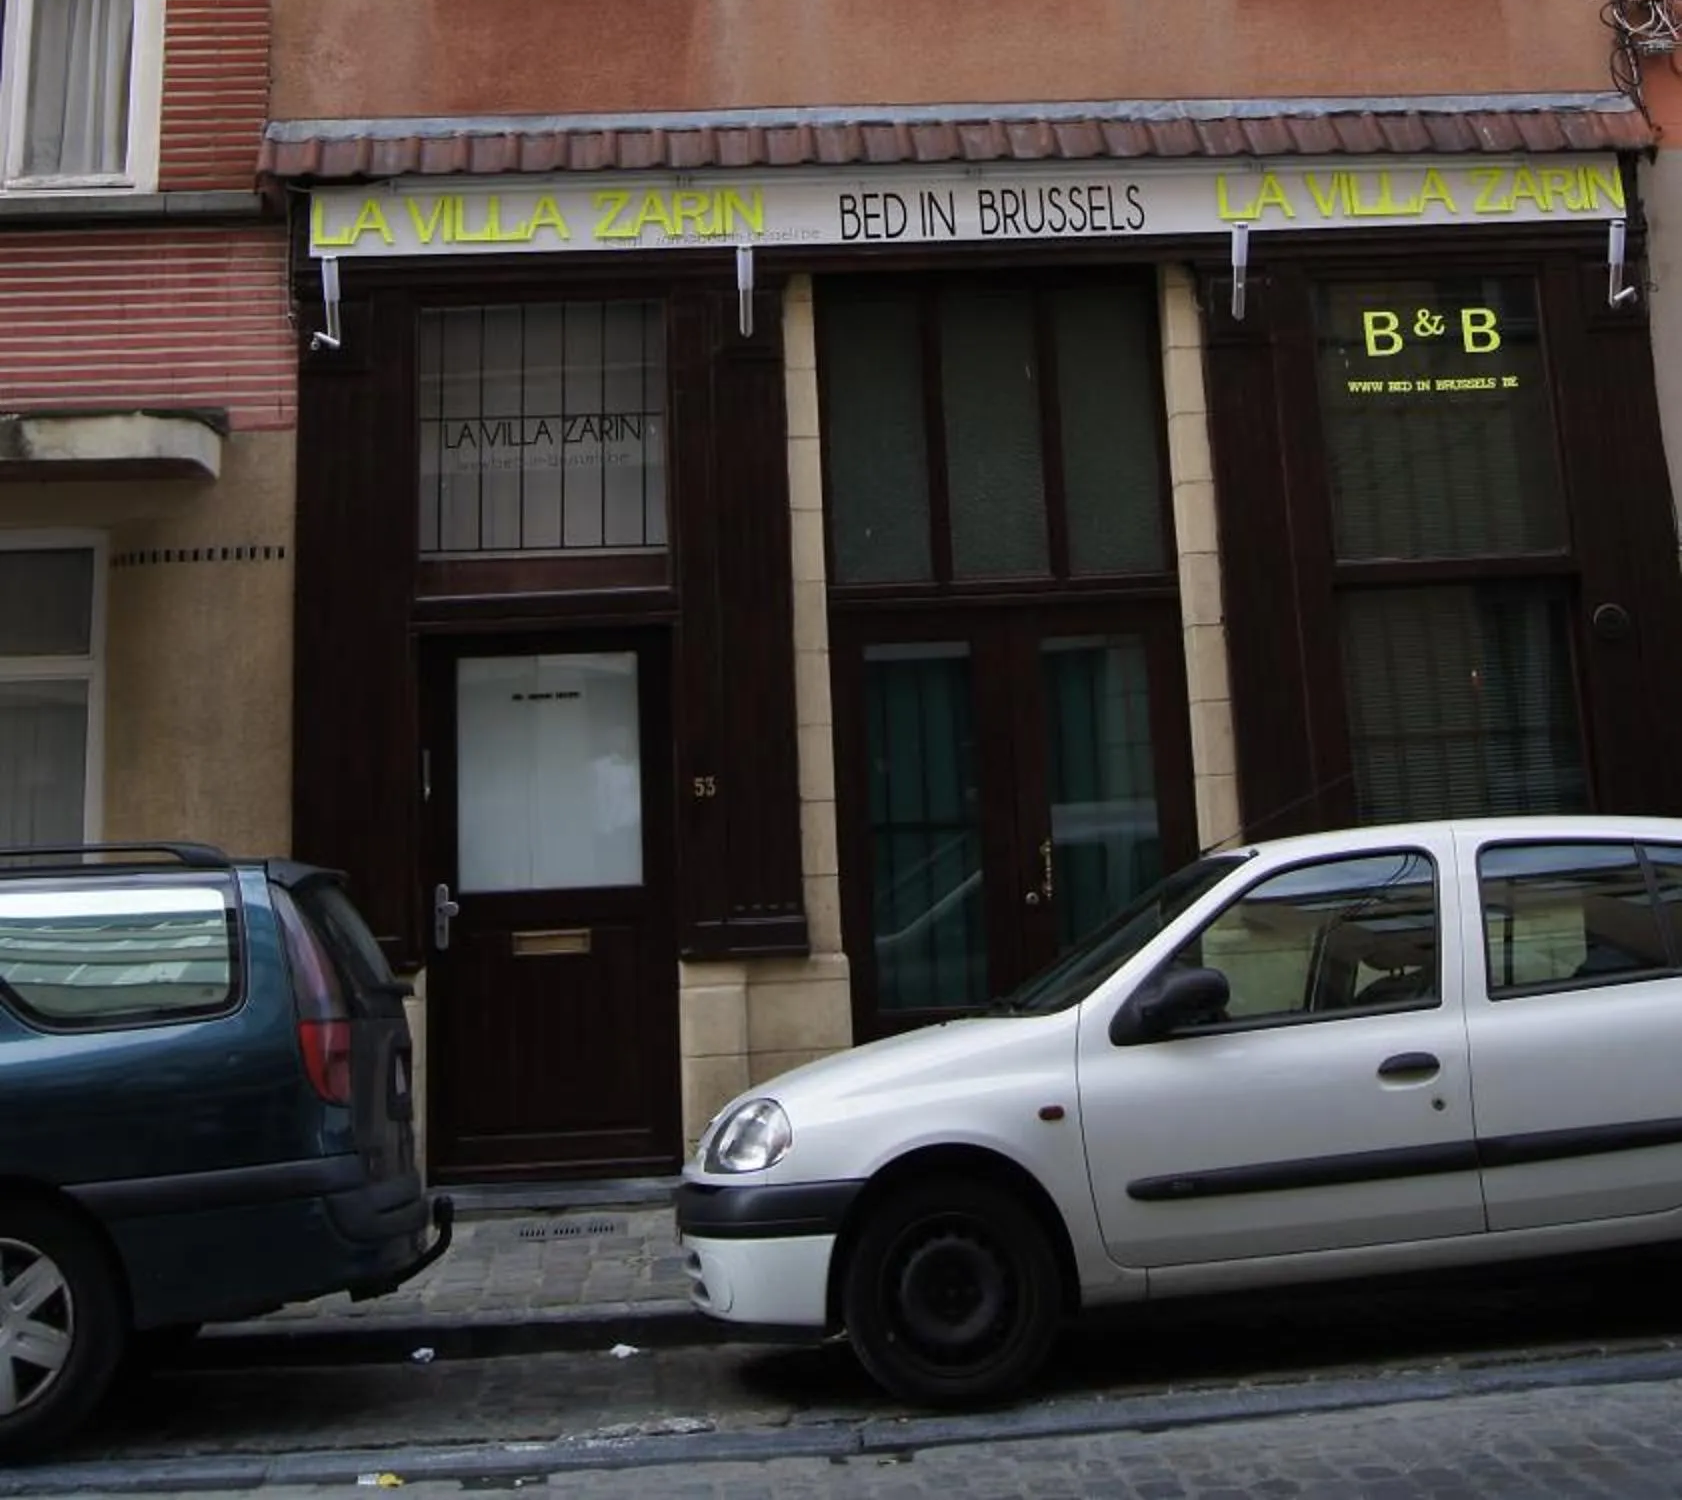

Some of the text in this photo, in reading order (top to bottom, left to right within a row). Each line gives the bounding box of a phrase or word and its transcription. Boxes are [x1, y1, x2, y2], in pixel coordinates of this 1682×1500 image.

[311, 187, 766, 246] LA VILLA ZARIN
[839, 192, 907, 240] BED
[919, 190, 956, 237] IN
[978, 184, 1146, 235] BRUSSELS
[1216, 164, 1627, 221] LA VILLA ZARIN
[1363, 307, 1501, 357] B & B
[444, 414, 642, 449] LA VILLA ZARIN
[695, 776, 717, 798] 53
